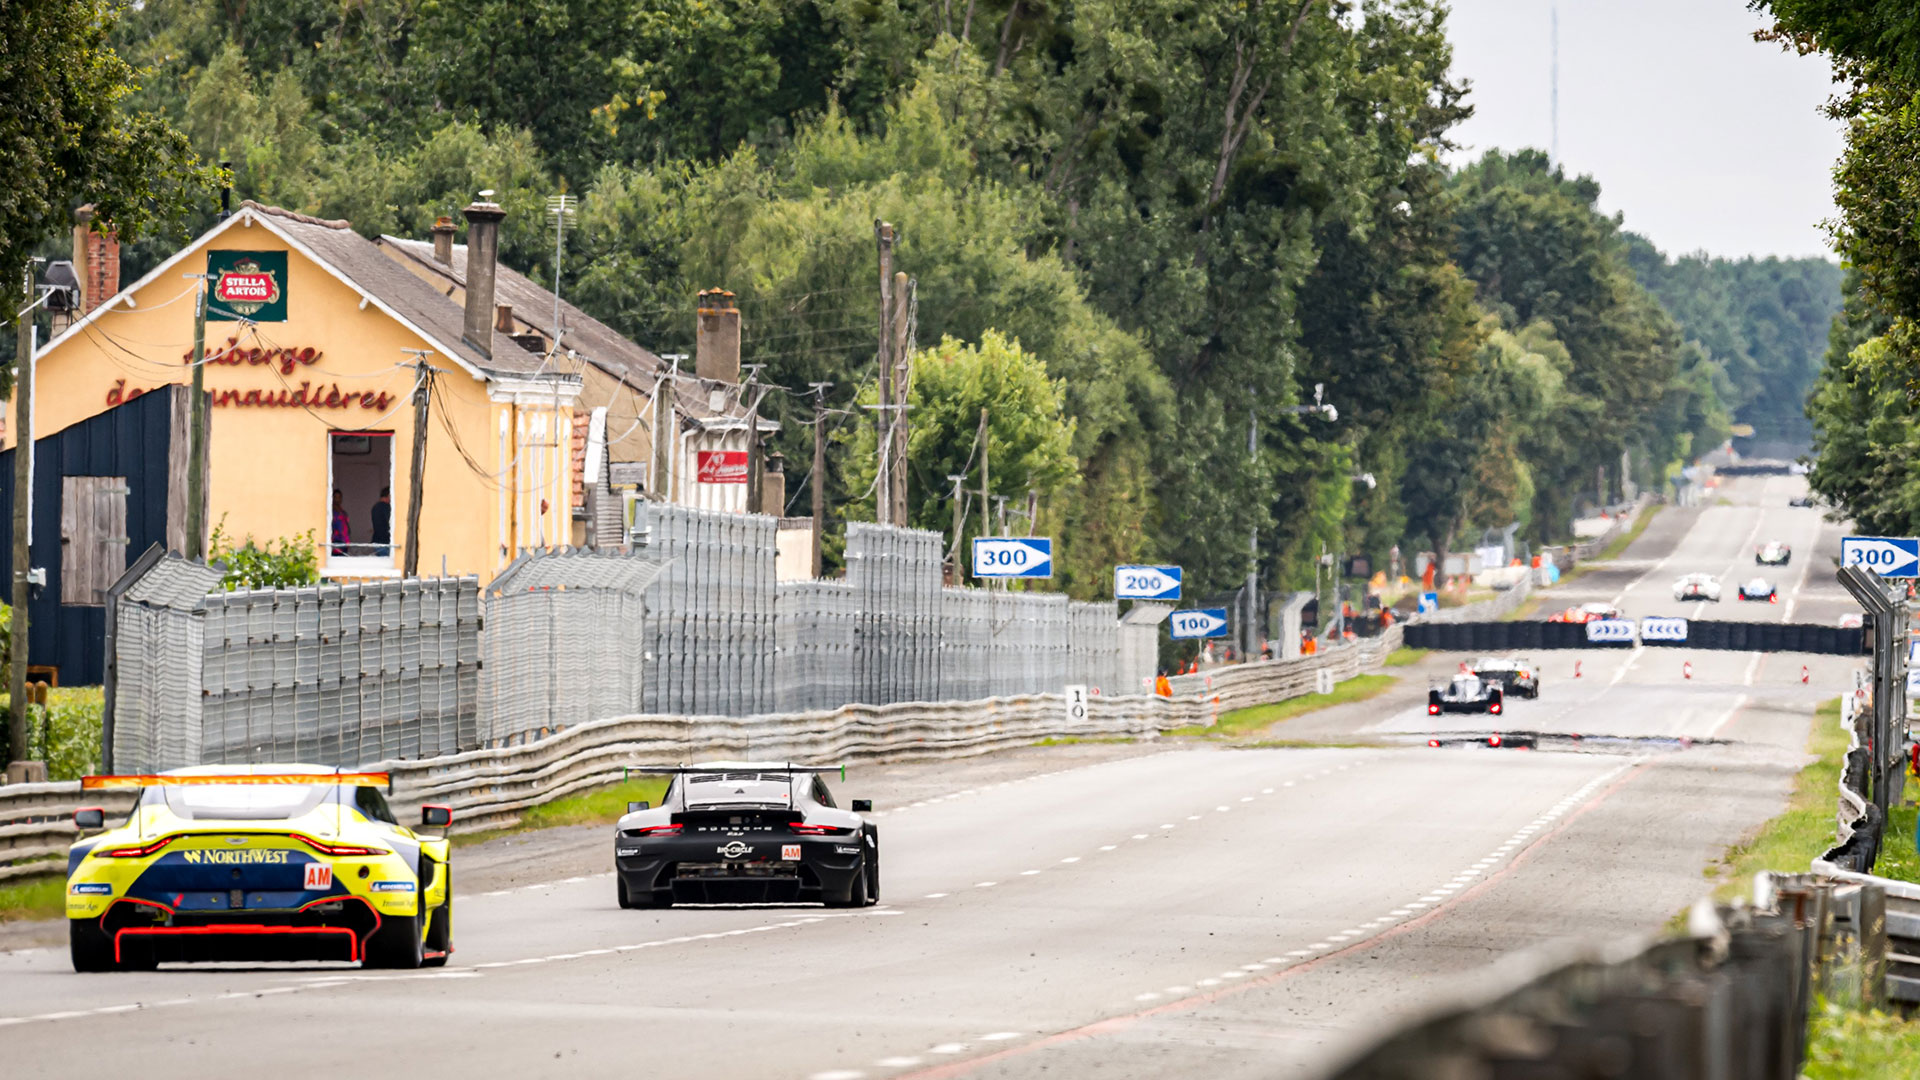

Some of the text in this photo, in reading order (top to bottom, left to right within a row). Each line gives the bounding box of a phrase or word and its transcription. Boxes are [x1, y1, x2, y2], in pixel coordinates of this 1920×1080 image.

[226, 277, 267, 287] STELLA
[226, 286, 268, 297] ARTOIS
[983, 549, 1028, 567] 300
[1851, 548, 1896, 565] 300
[1125, 574, 1162, 591] 200
[1178, 617, 1210, 632] 100
[783, 846, 801, 859] AM
[306, 867, 331, 886] AM
